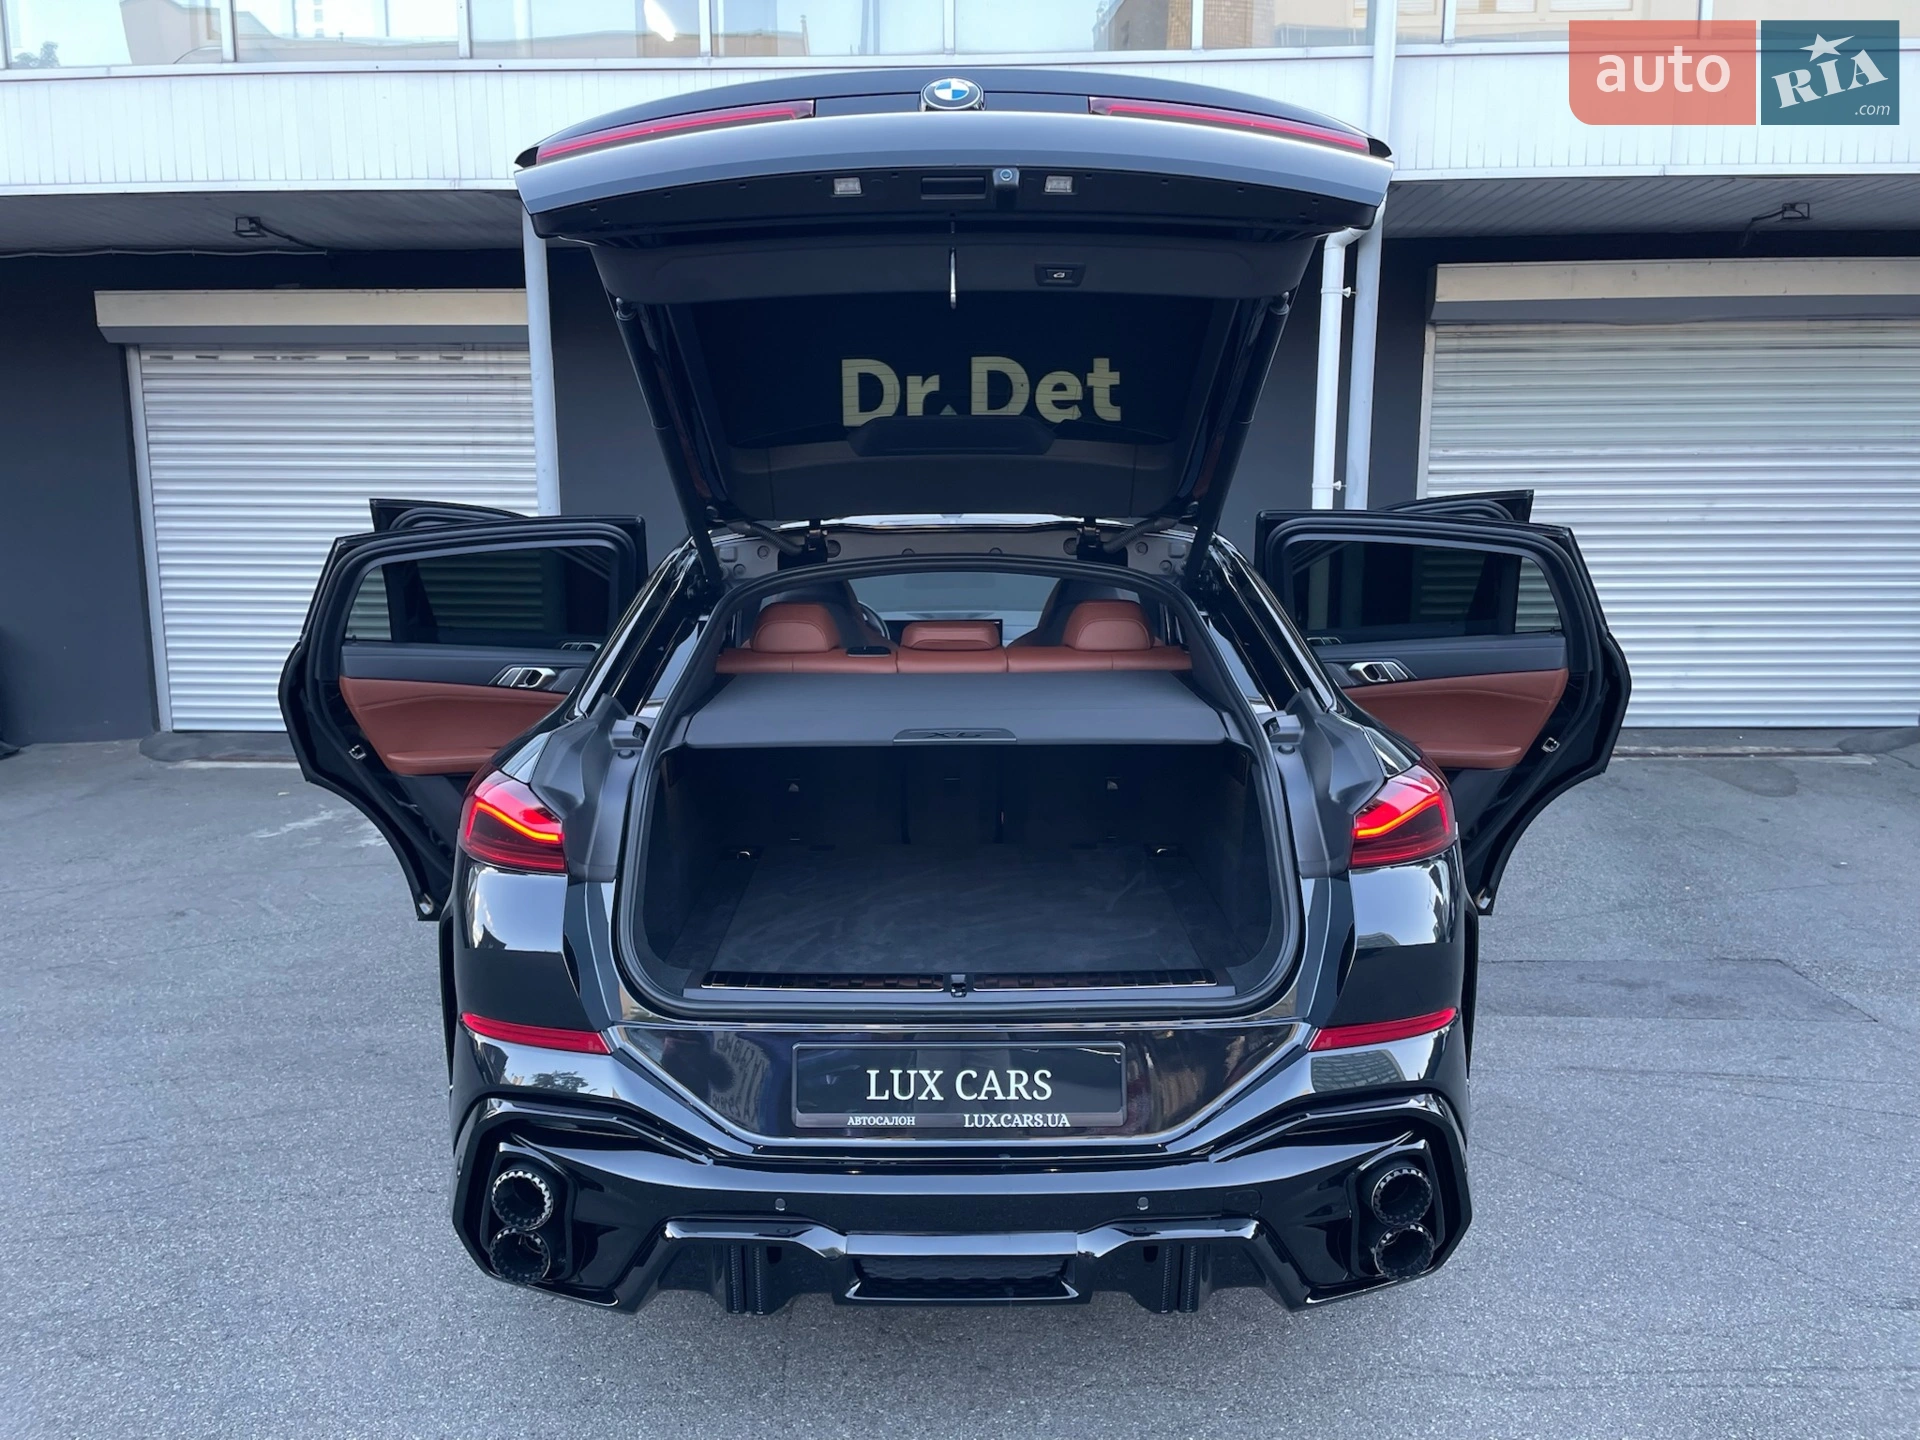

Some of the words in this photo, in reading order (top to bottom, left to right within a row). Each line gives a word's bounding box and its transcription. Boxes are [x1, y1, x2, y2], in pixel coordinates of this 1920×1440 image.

[971, 356, 1122, 424] Det
[866, 1069, 944, 1101] LUX
[955, 1069, 1053, 1101] CARS
[847, 1115, 916, 1127] АВТОСАЛОН
[963, 1113, 1071, 1128] LUX.CARS.UA
